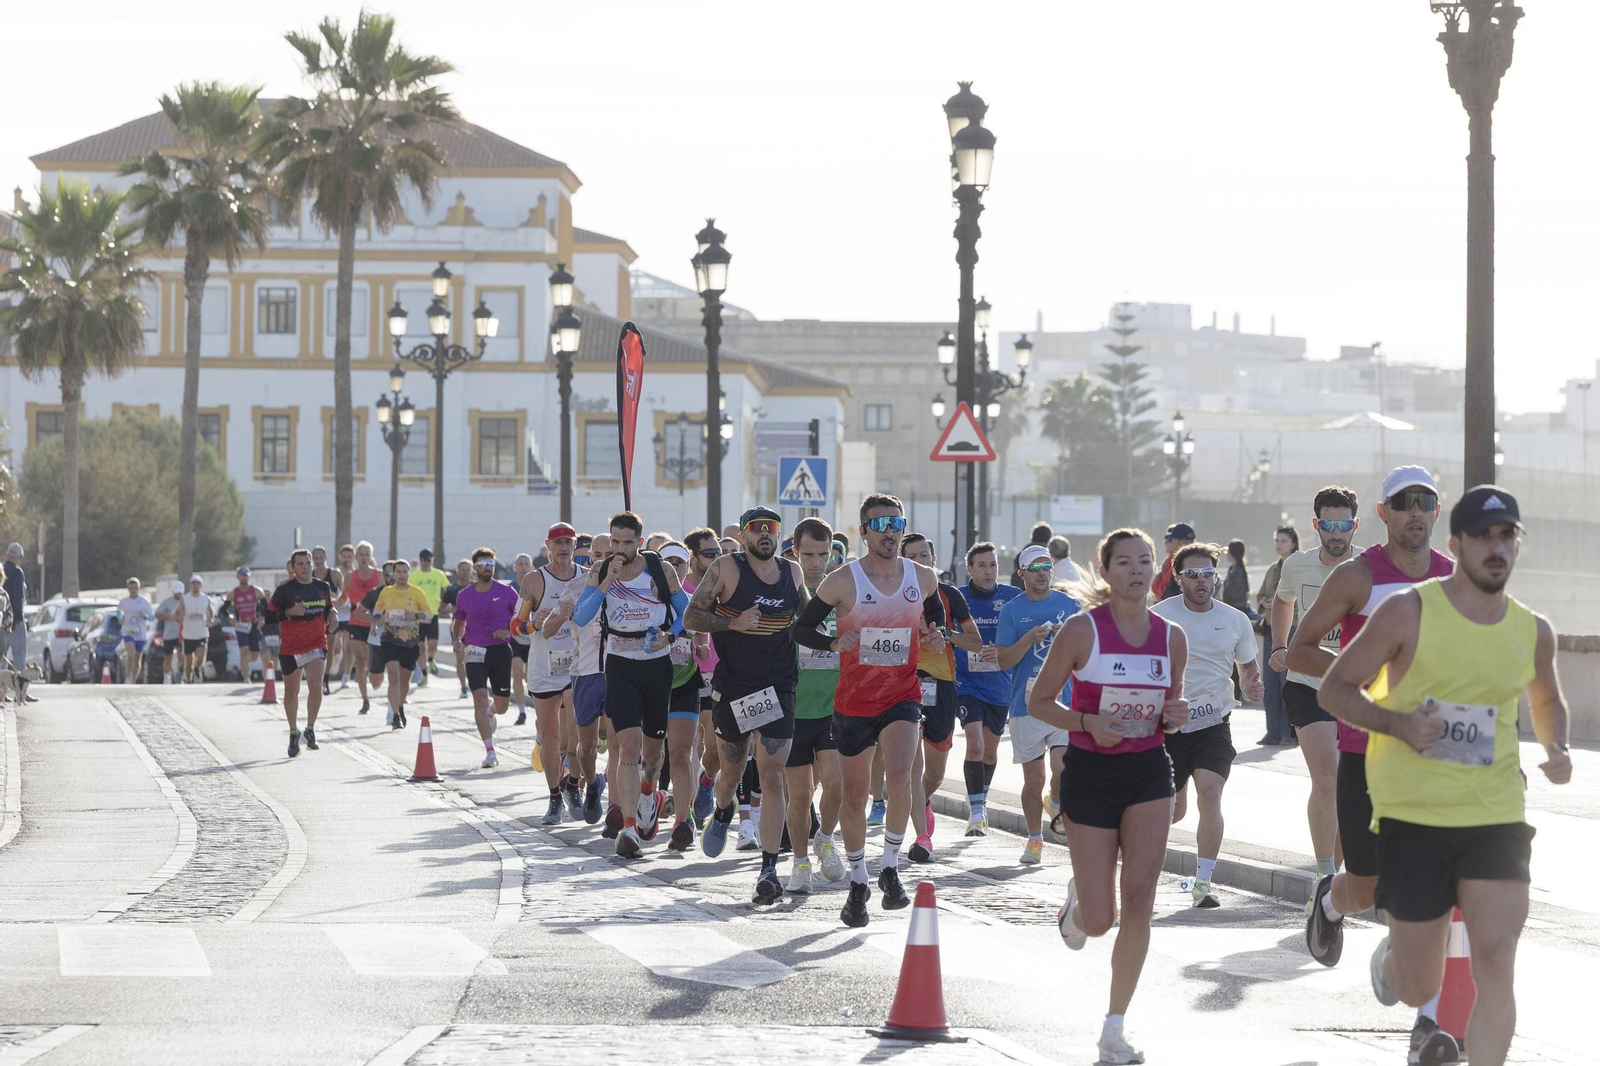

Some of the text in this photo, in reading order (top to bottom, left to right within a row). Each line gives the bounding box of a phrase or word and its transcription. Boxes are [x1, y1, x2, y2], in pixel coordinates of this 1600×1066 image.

[872, 639, 901, 653] 486
[740, 698, 773, 719] 1828
[1109, 702, 1156, 721] 2282
